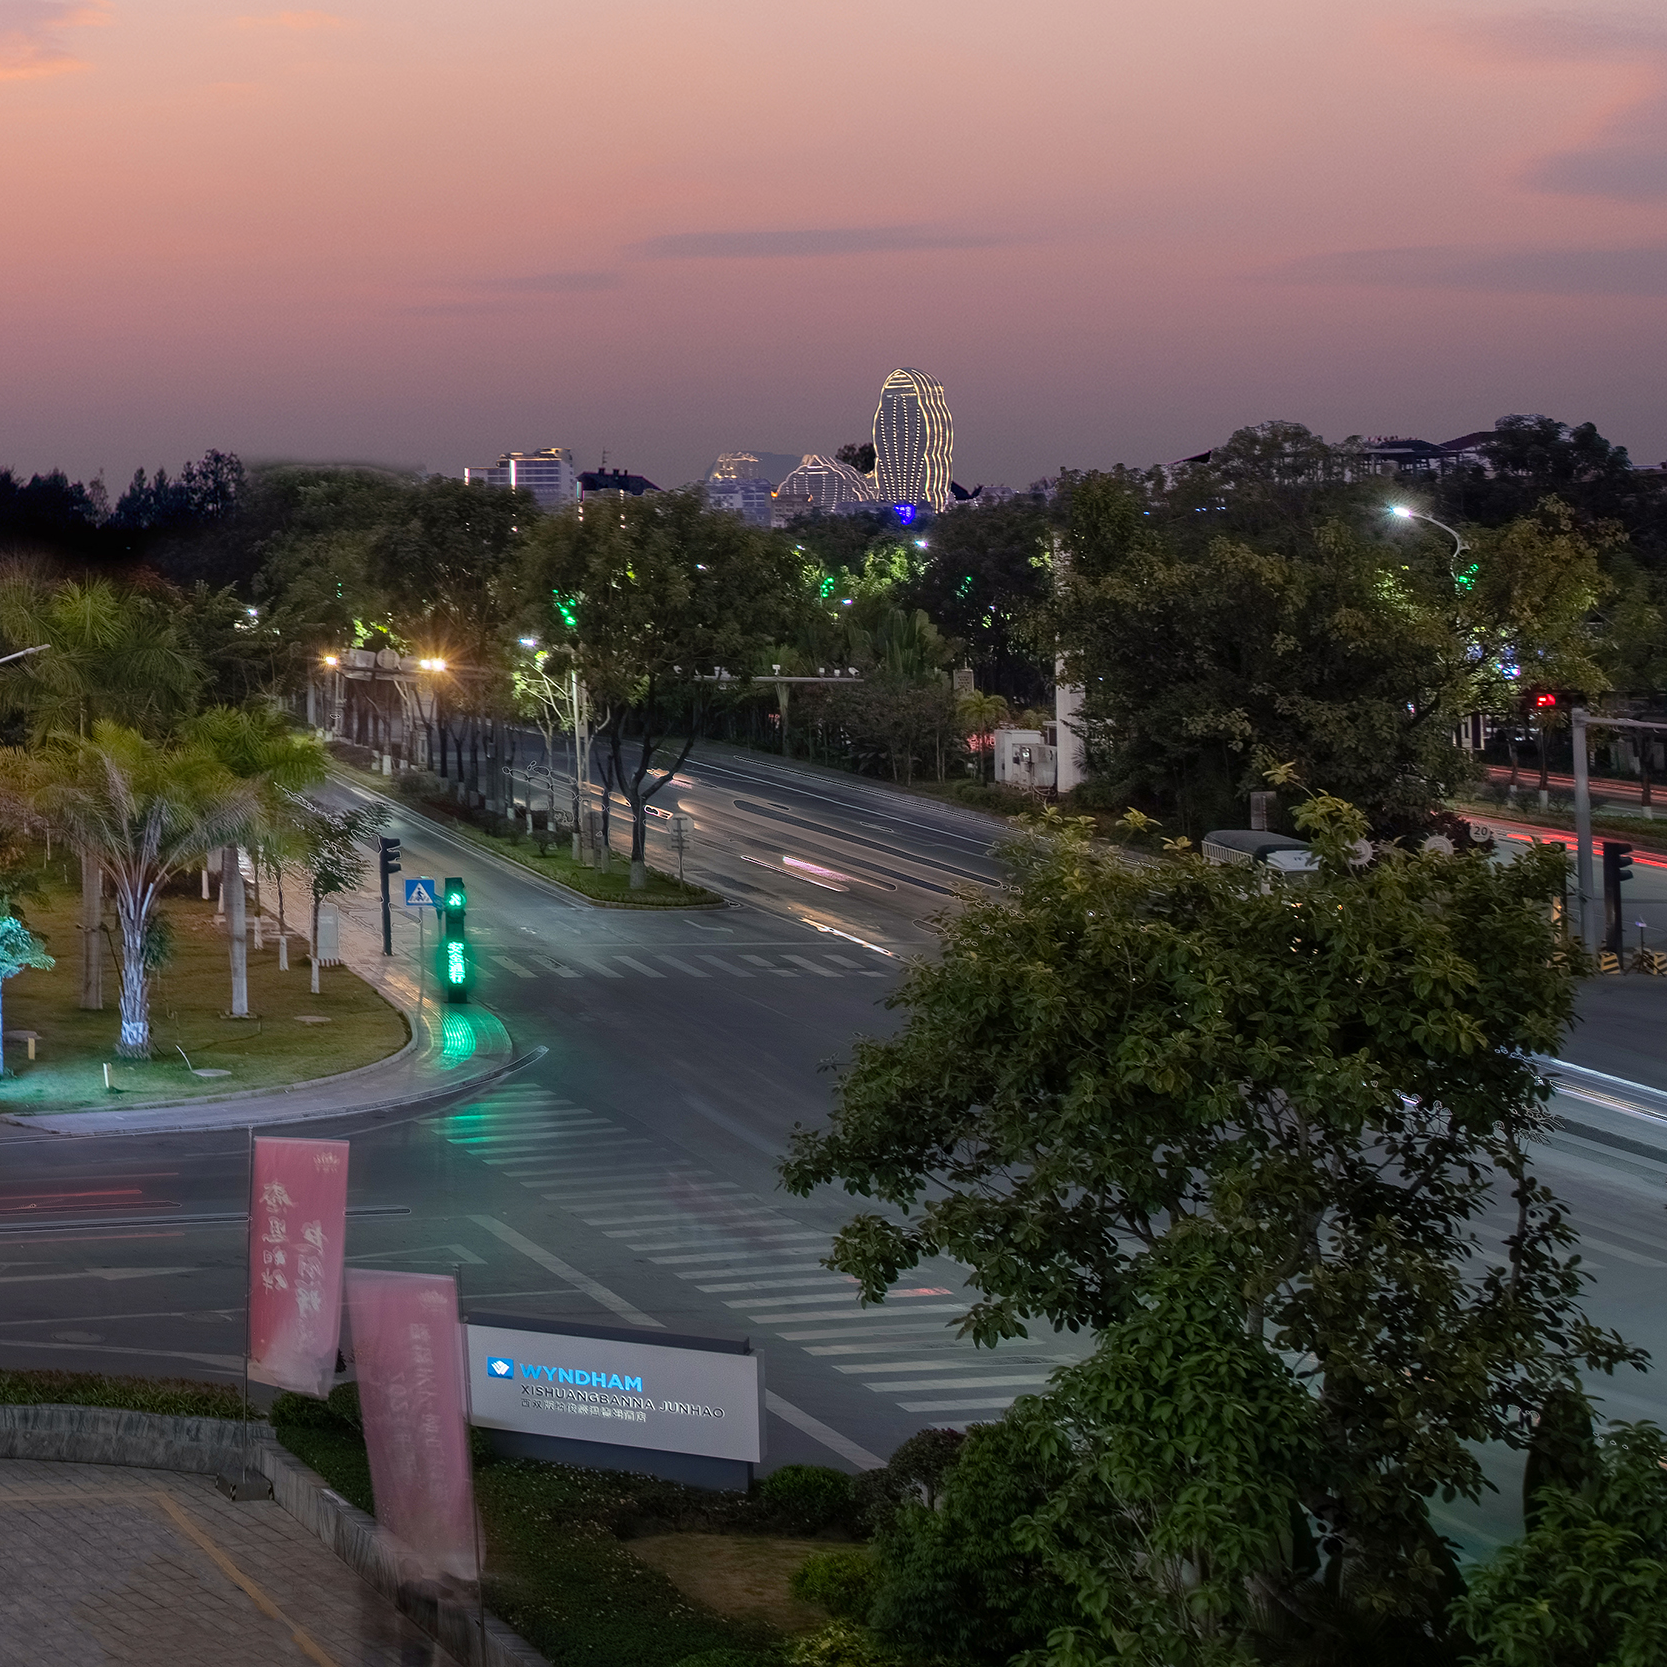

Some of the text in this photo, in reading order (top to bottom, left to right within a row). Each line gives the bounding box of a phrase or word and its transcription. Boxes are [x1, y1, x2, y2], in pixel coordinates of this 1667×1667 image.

[1474, 826, 1487, 836] 20
[519, 1362, 643, 1393] WYNDHAM
[520, 1384, 726, 1420] XISHUANGBANNA JUNHAO
